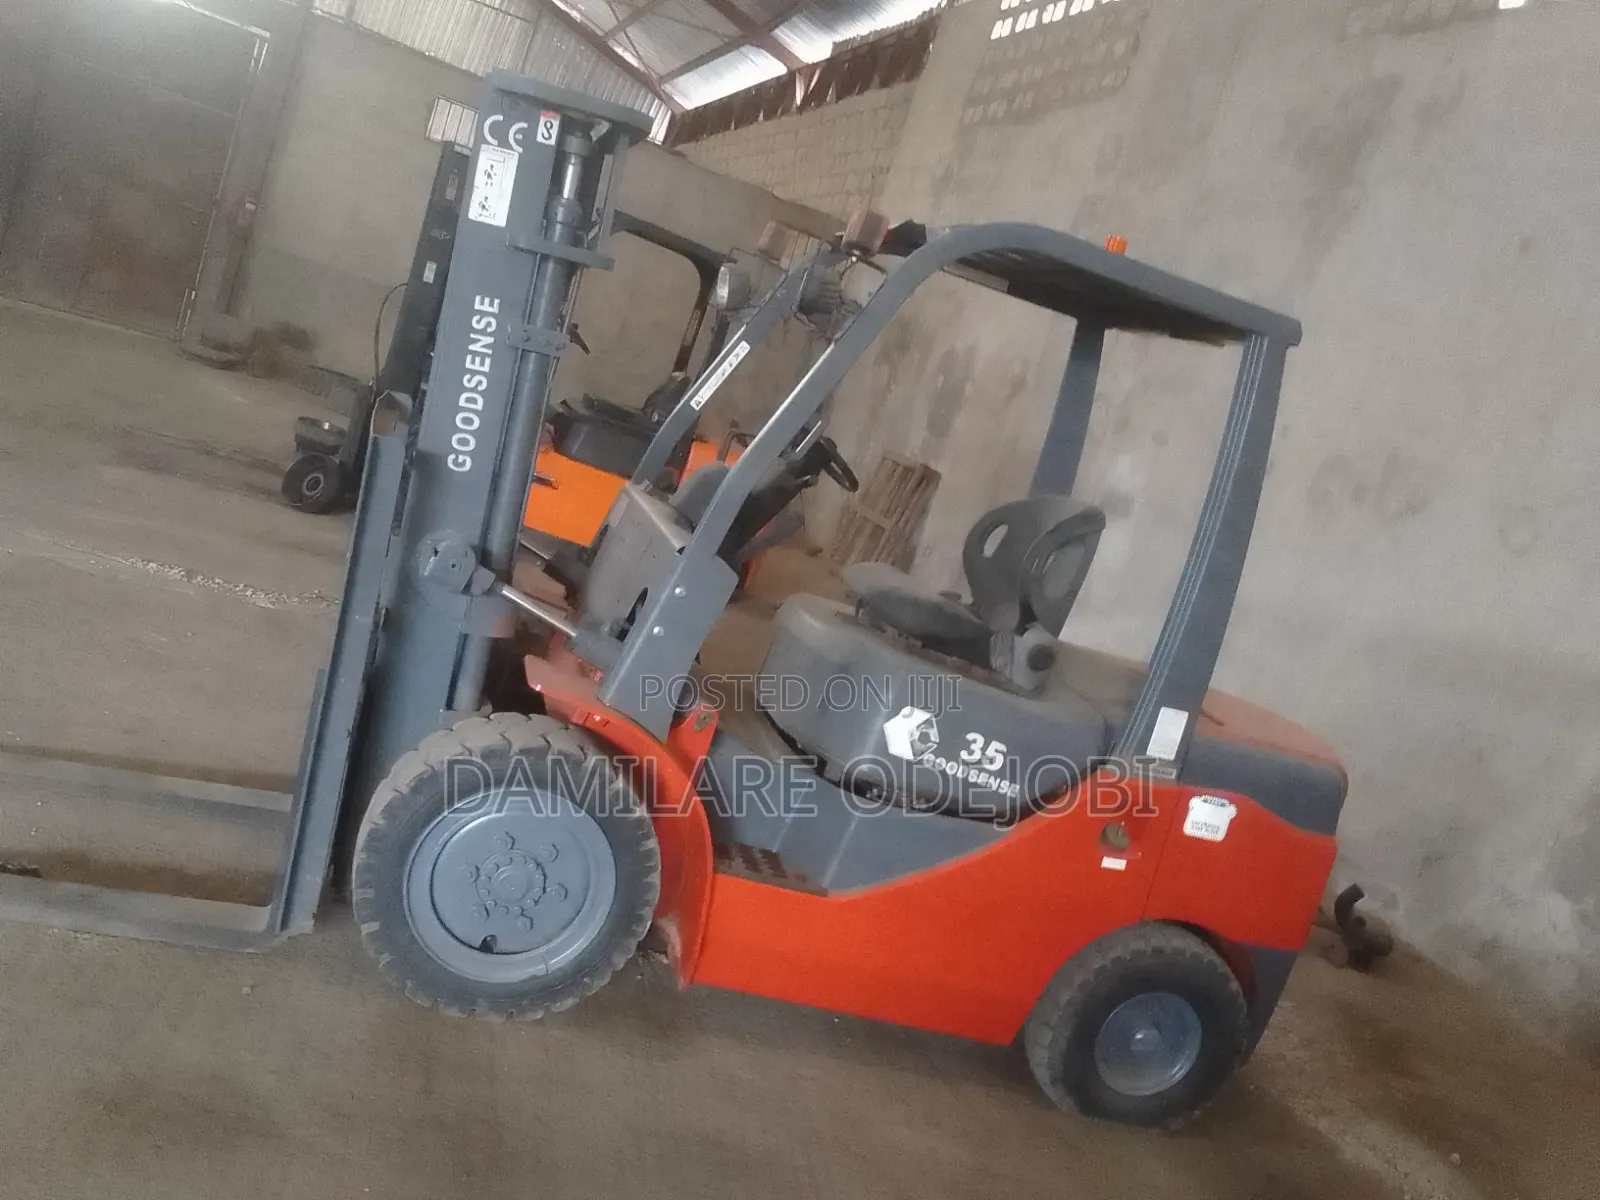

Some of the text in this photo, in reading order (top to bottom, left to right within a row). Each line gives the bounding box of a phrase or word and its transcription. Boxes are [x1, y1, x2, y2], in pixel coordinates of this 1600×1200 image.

[483, 114, 528, 153] CE
[447, 294, 500, 472] GOODSENSE
[960, 732, 1008, 771] 35
[922, 753, 1020, 798] GOODSENSE
